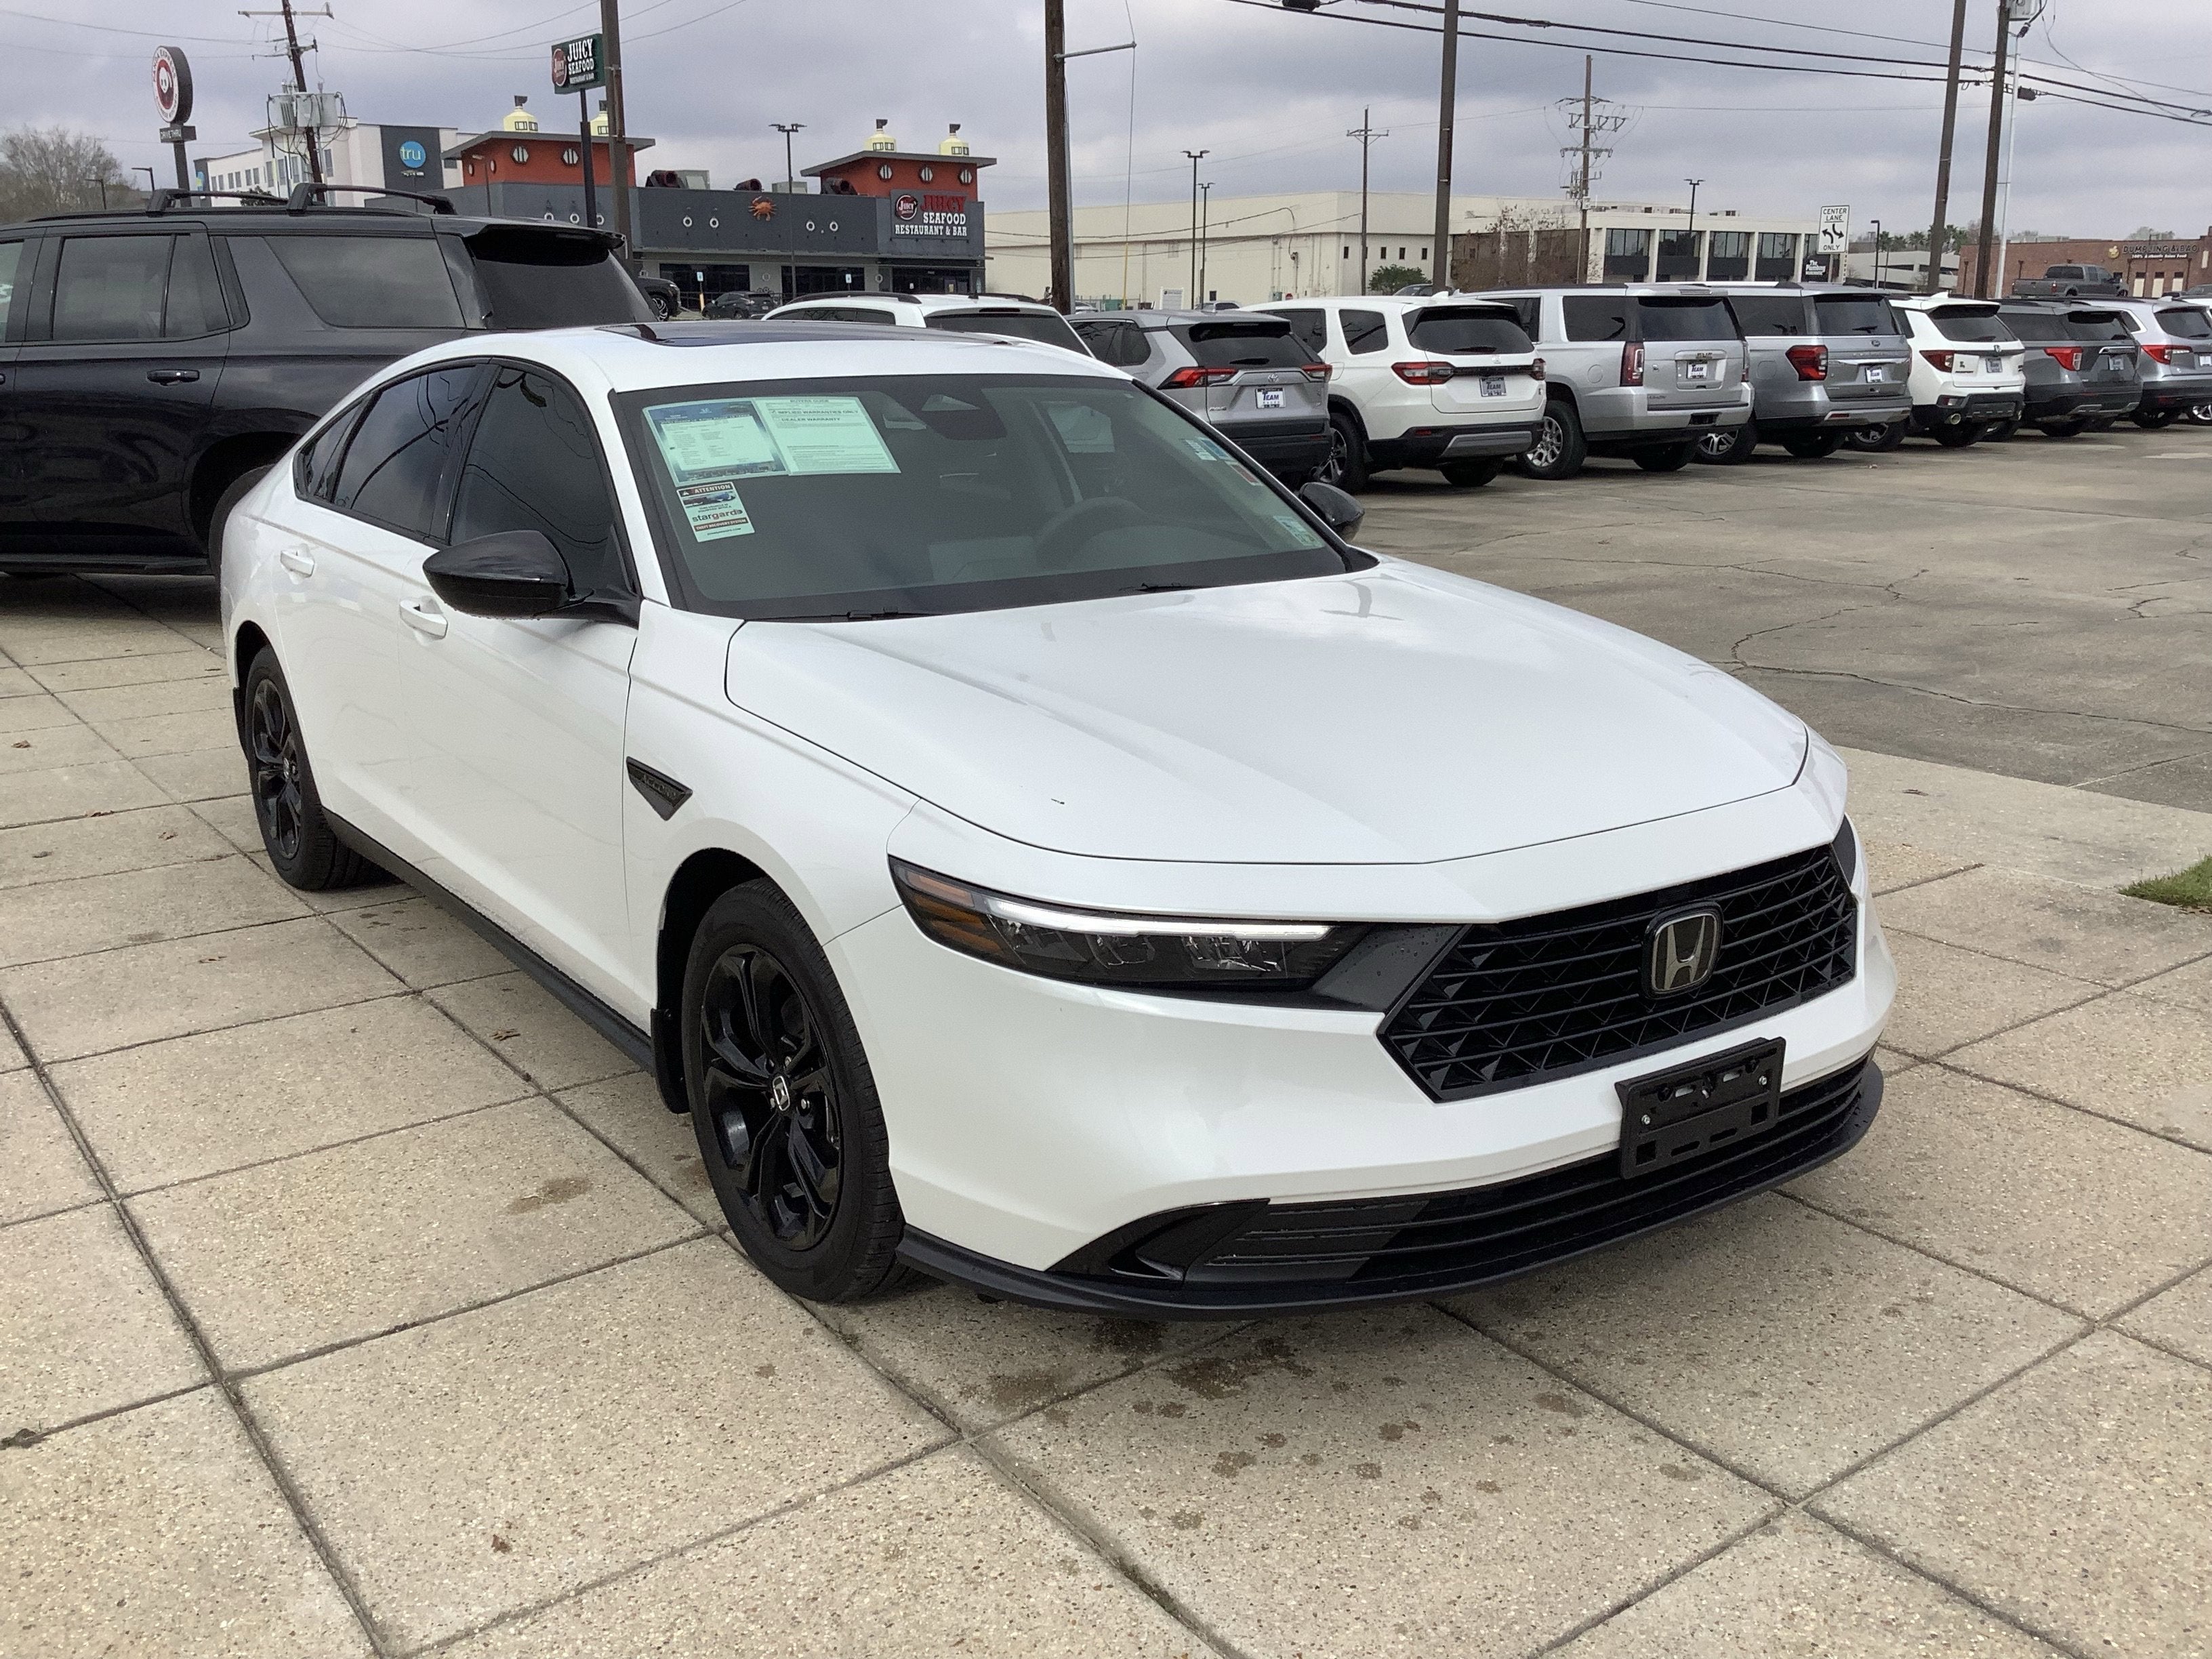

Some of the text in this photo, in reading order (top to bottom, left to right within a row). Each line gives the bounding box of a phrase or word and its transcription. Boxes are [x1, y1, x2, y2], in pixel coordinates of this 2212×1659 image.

[567, 38, 593, 62] JUICY
[568, 58, 594, 75] SEAFOOD
[400, 146, 422, 161] tru
[920, 194, 966, 212] JUICY
[923, 212, 966, 225] SEAFOOD
[895, 224, 967, 237] RESTAURANT & BAR
[1486, 382, 1501, 390] TEAM
[1263, 391, 1279, 401] TEAM
[694, 484, 731, 494] ATTENTION
